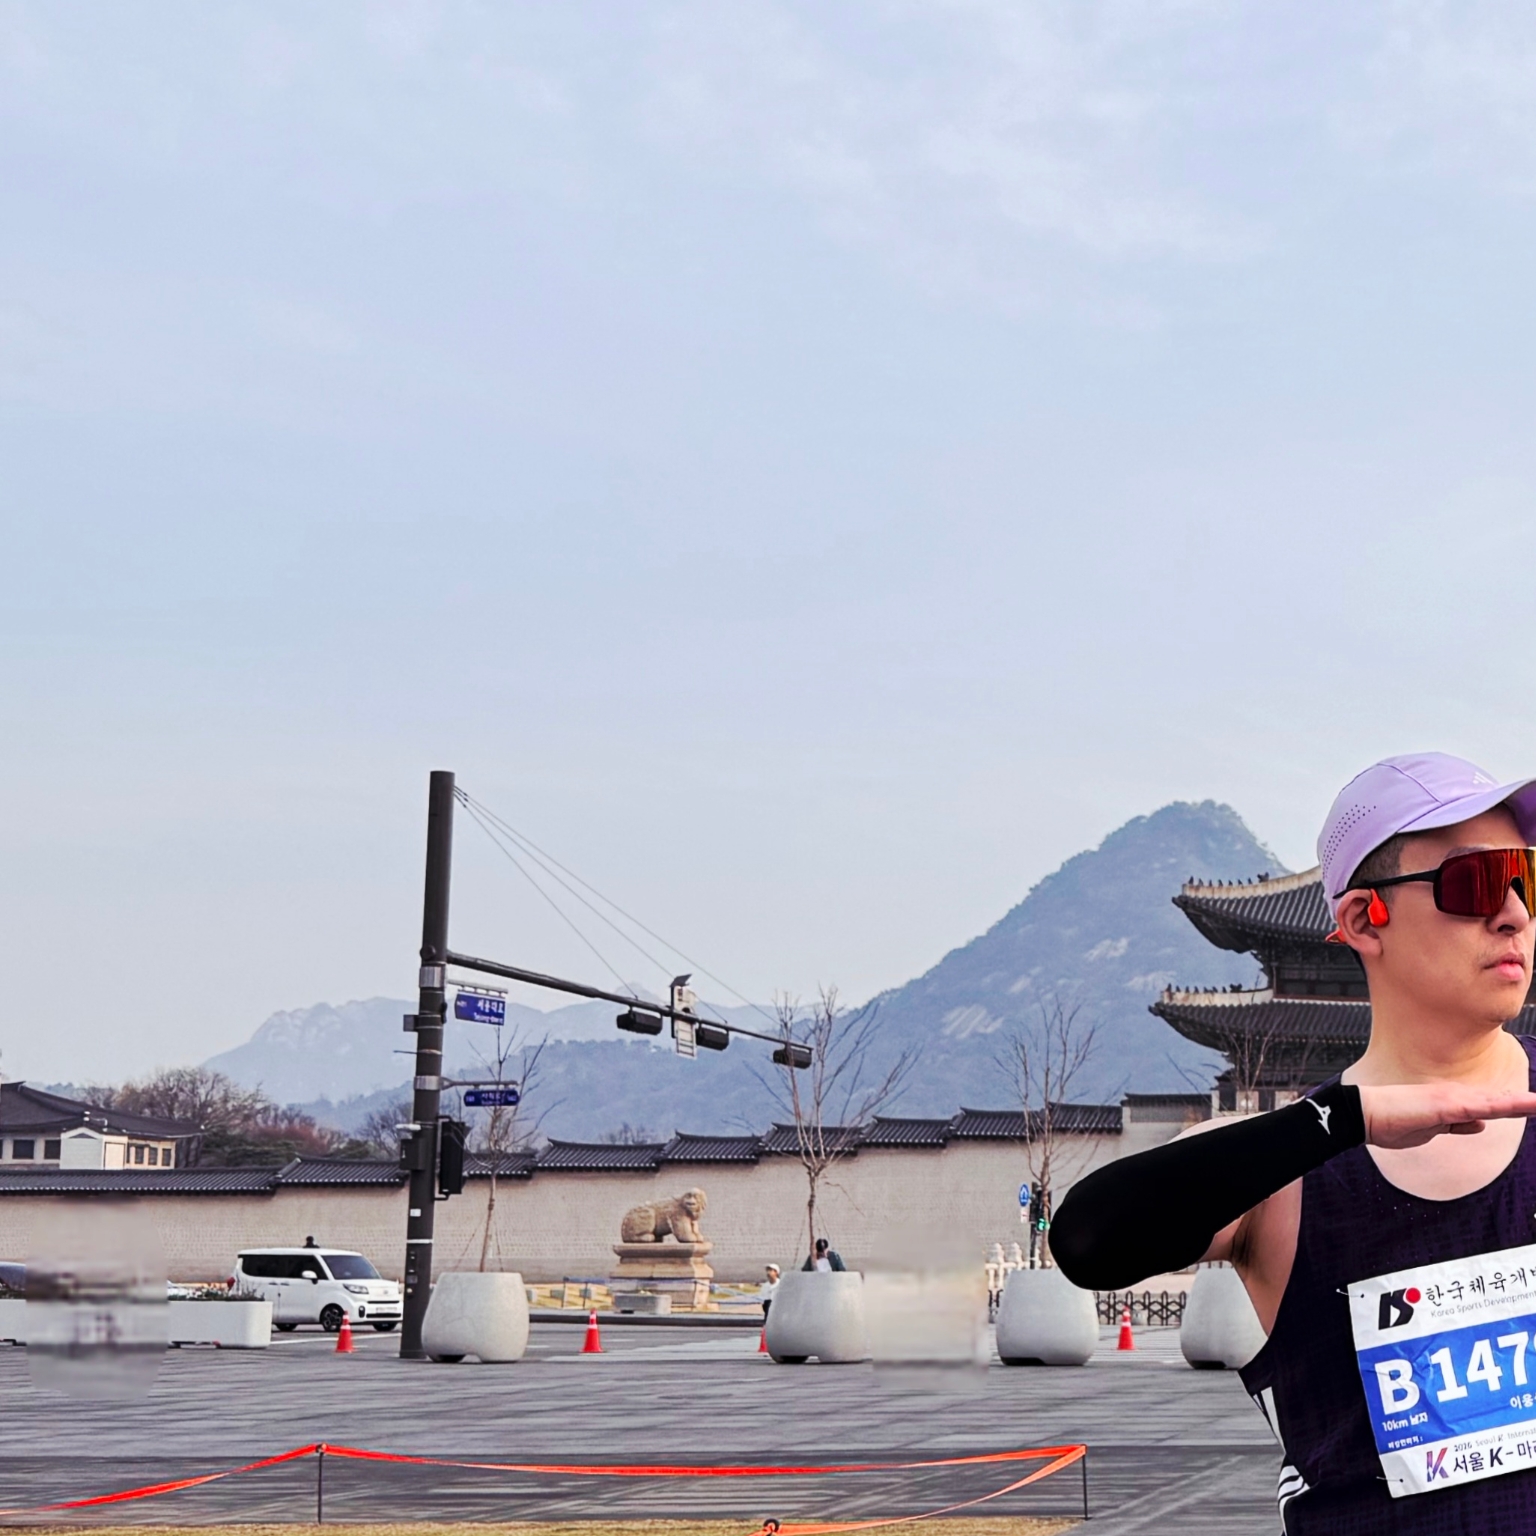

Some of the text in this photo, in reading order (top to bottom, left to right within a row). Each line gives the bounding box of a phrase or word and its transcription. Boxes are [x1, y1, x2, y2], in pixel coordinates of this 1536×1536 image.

[1430, 1307, 1455, 1318] Korea
[1456, 1302, 1482, 1313] Sports
[1374, 1358, 1421, 1415] B
[1382, 1419, 1409, 1432] 10km
[1475, 1435, 1496, 1447] Seoul
[1453, 1451, 1485, 1474] 서울
